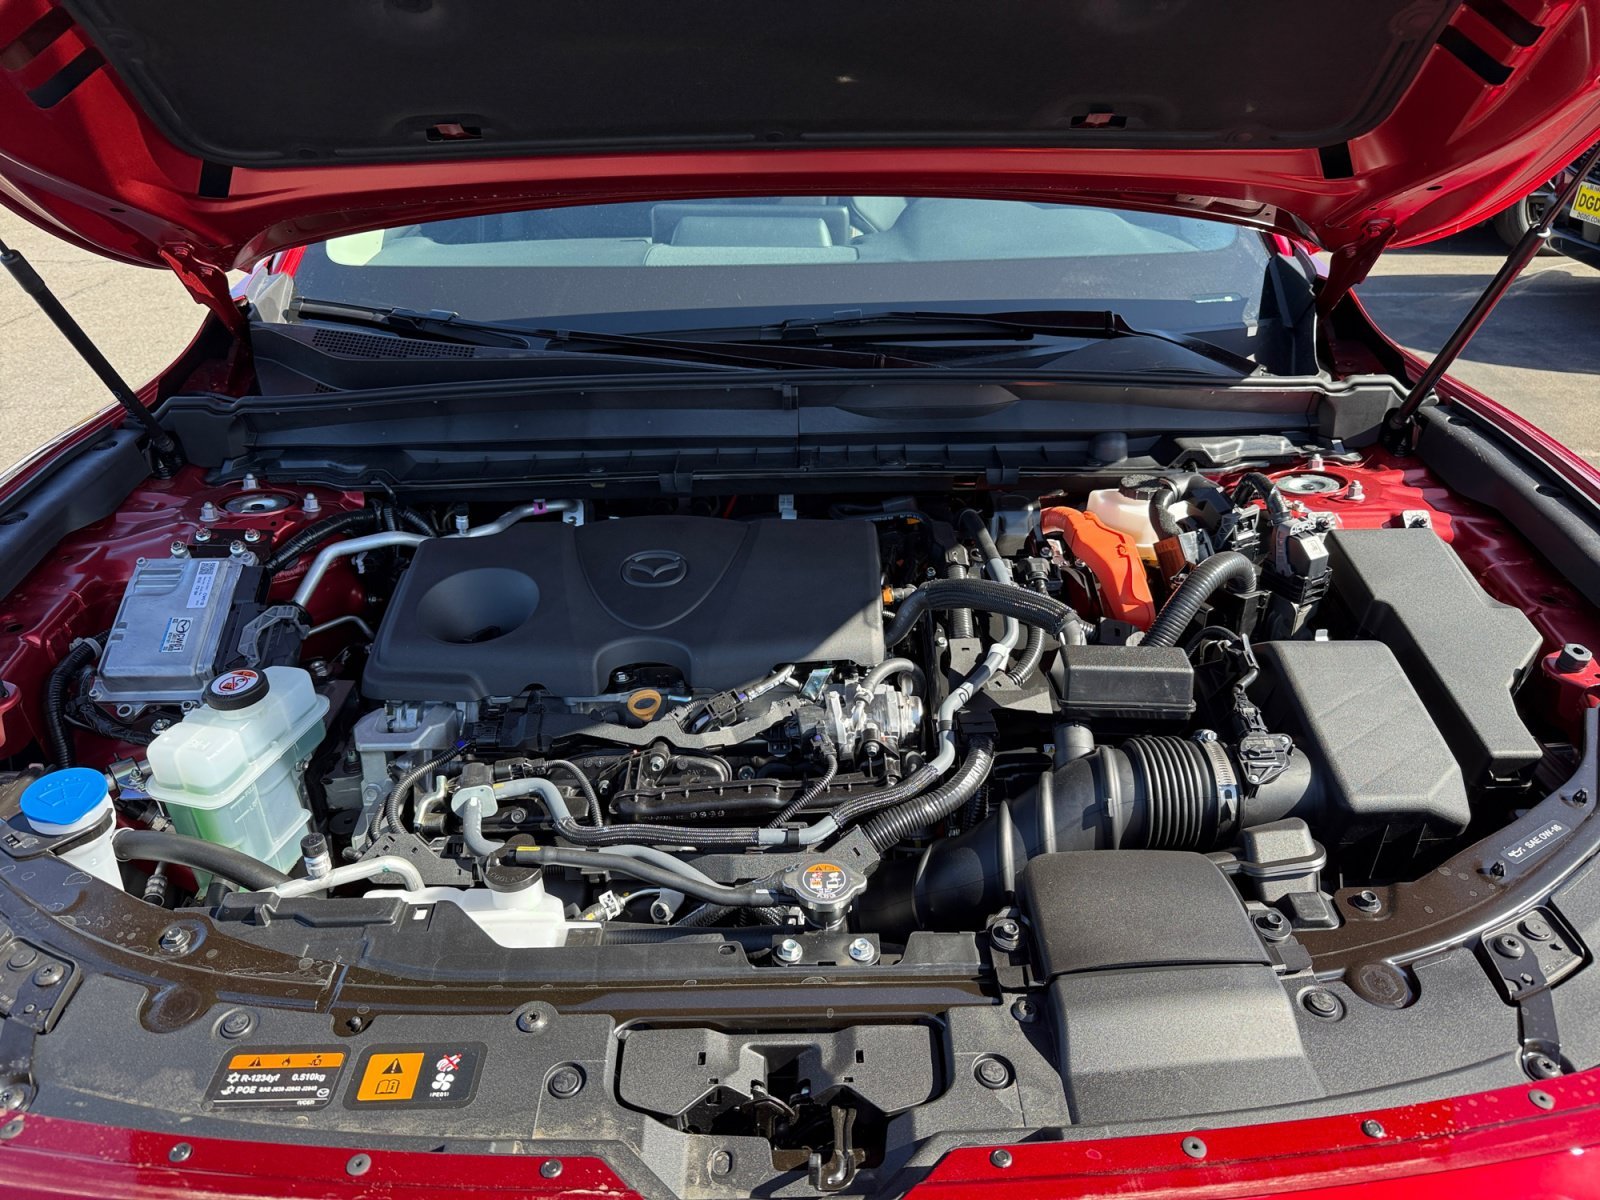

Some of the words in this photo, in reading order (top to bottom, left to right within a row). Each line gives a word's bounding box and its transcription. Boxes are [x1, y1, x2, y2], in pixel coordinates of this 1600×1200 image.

[1524, 836, 1543, 849] SAE
[489, 871, 529, 882] COOLANT
[240, 1073, 280, 1083] R-1234yf
[291, 1072, 326, 1082] 0.510kg
[235, 1085, 257, 1094] POE
